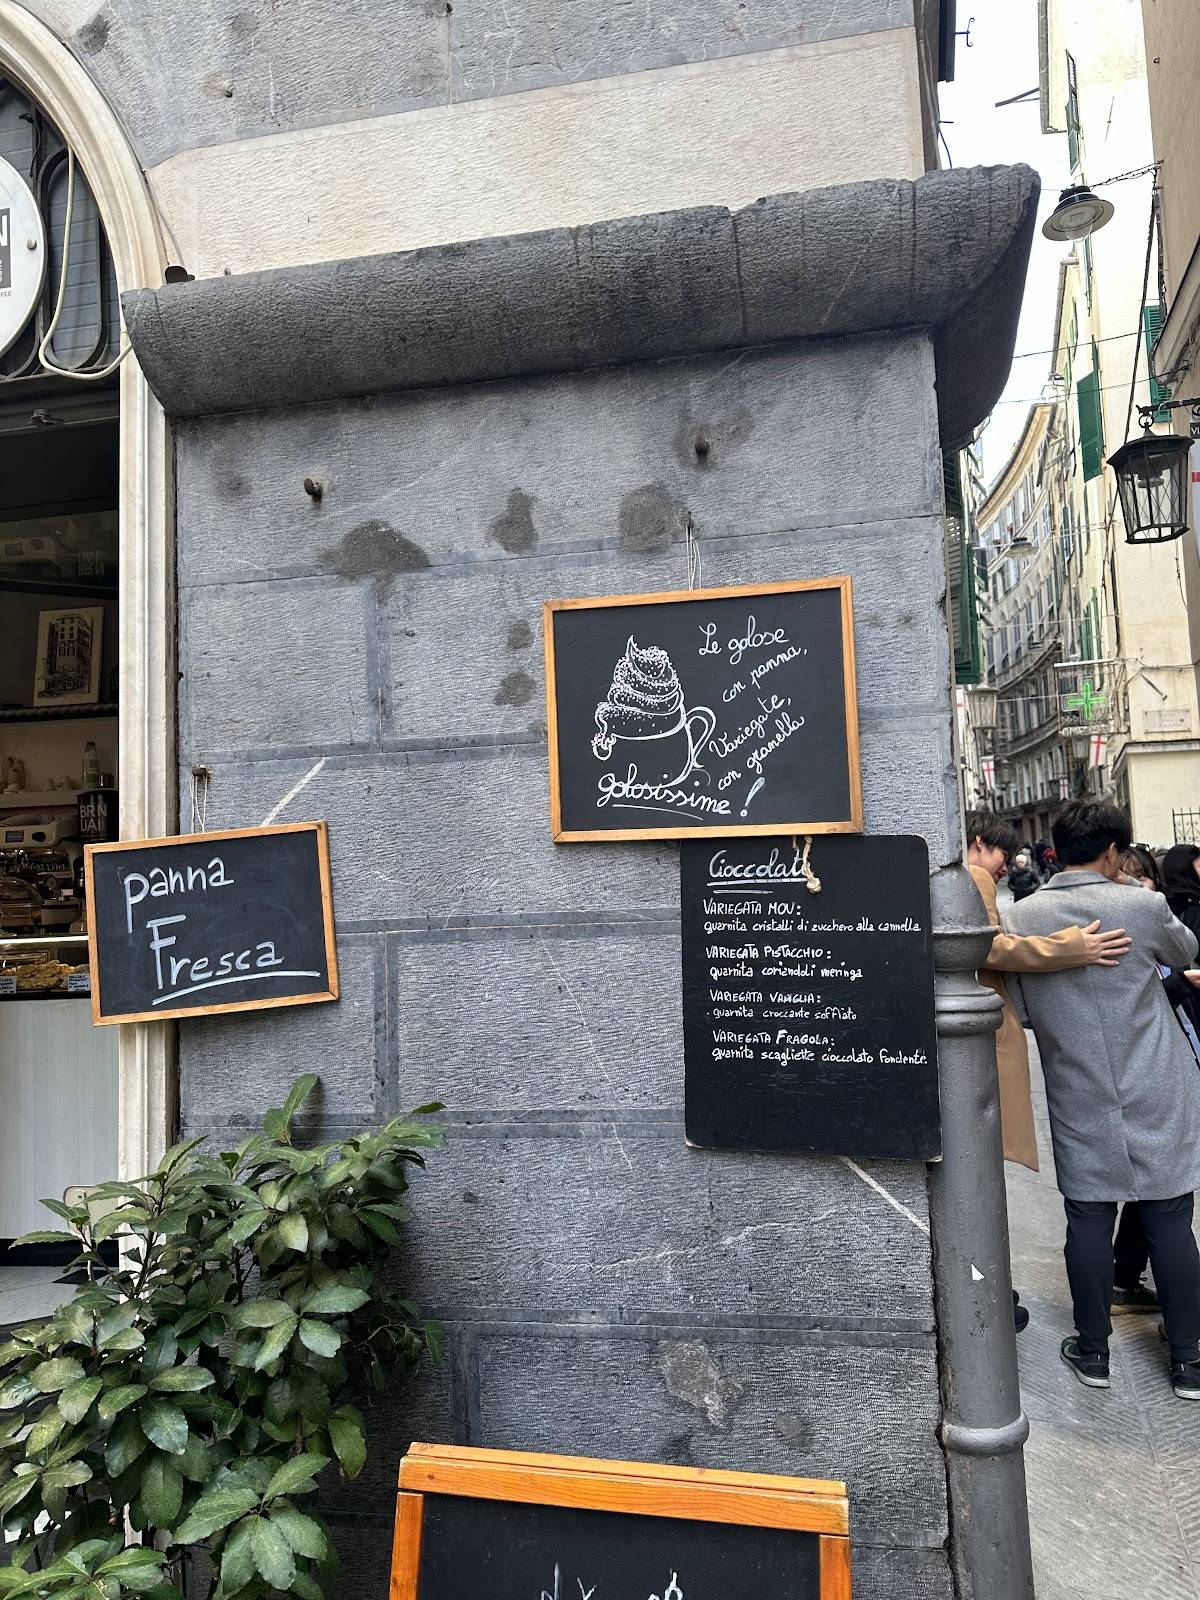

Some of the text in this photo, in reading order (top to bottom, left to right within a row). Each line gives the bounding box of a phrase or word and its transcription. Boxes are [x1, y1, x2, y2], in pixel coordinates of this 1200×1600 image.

[699, 615, 789, 665] Le golose
[723, 646, 807, 702] con panna,
[718, 770, 741, 790] con
[123, 857, 234, 934] panna
[703, 898, 761, 914] VARIEGATA
[704, 917, 747, 934] guarnita
[753, 919, 793, 931] cristalli
[797, 919, 809, 931] di
[812, 919, 853, 931] zucchero
[856, 917, 874, 931] alla
[146, 914, 284, 989] Fresca
[706, 944, 759, 959] VARIEGATA
[710, 961, 753, 981] guarnita
[821, 962, 863, 981] meringa
[710, 989, 762, 1002] VARIEGATA
[713, 1029, 771, 1043] VARIEGATA
